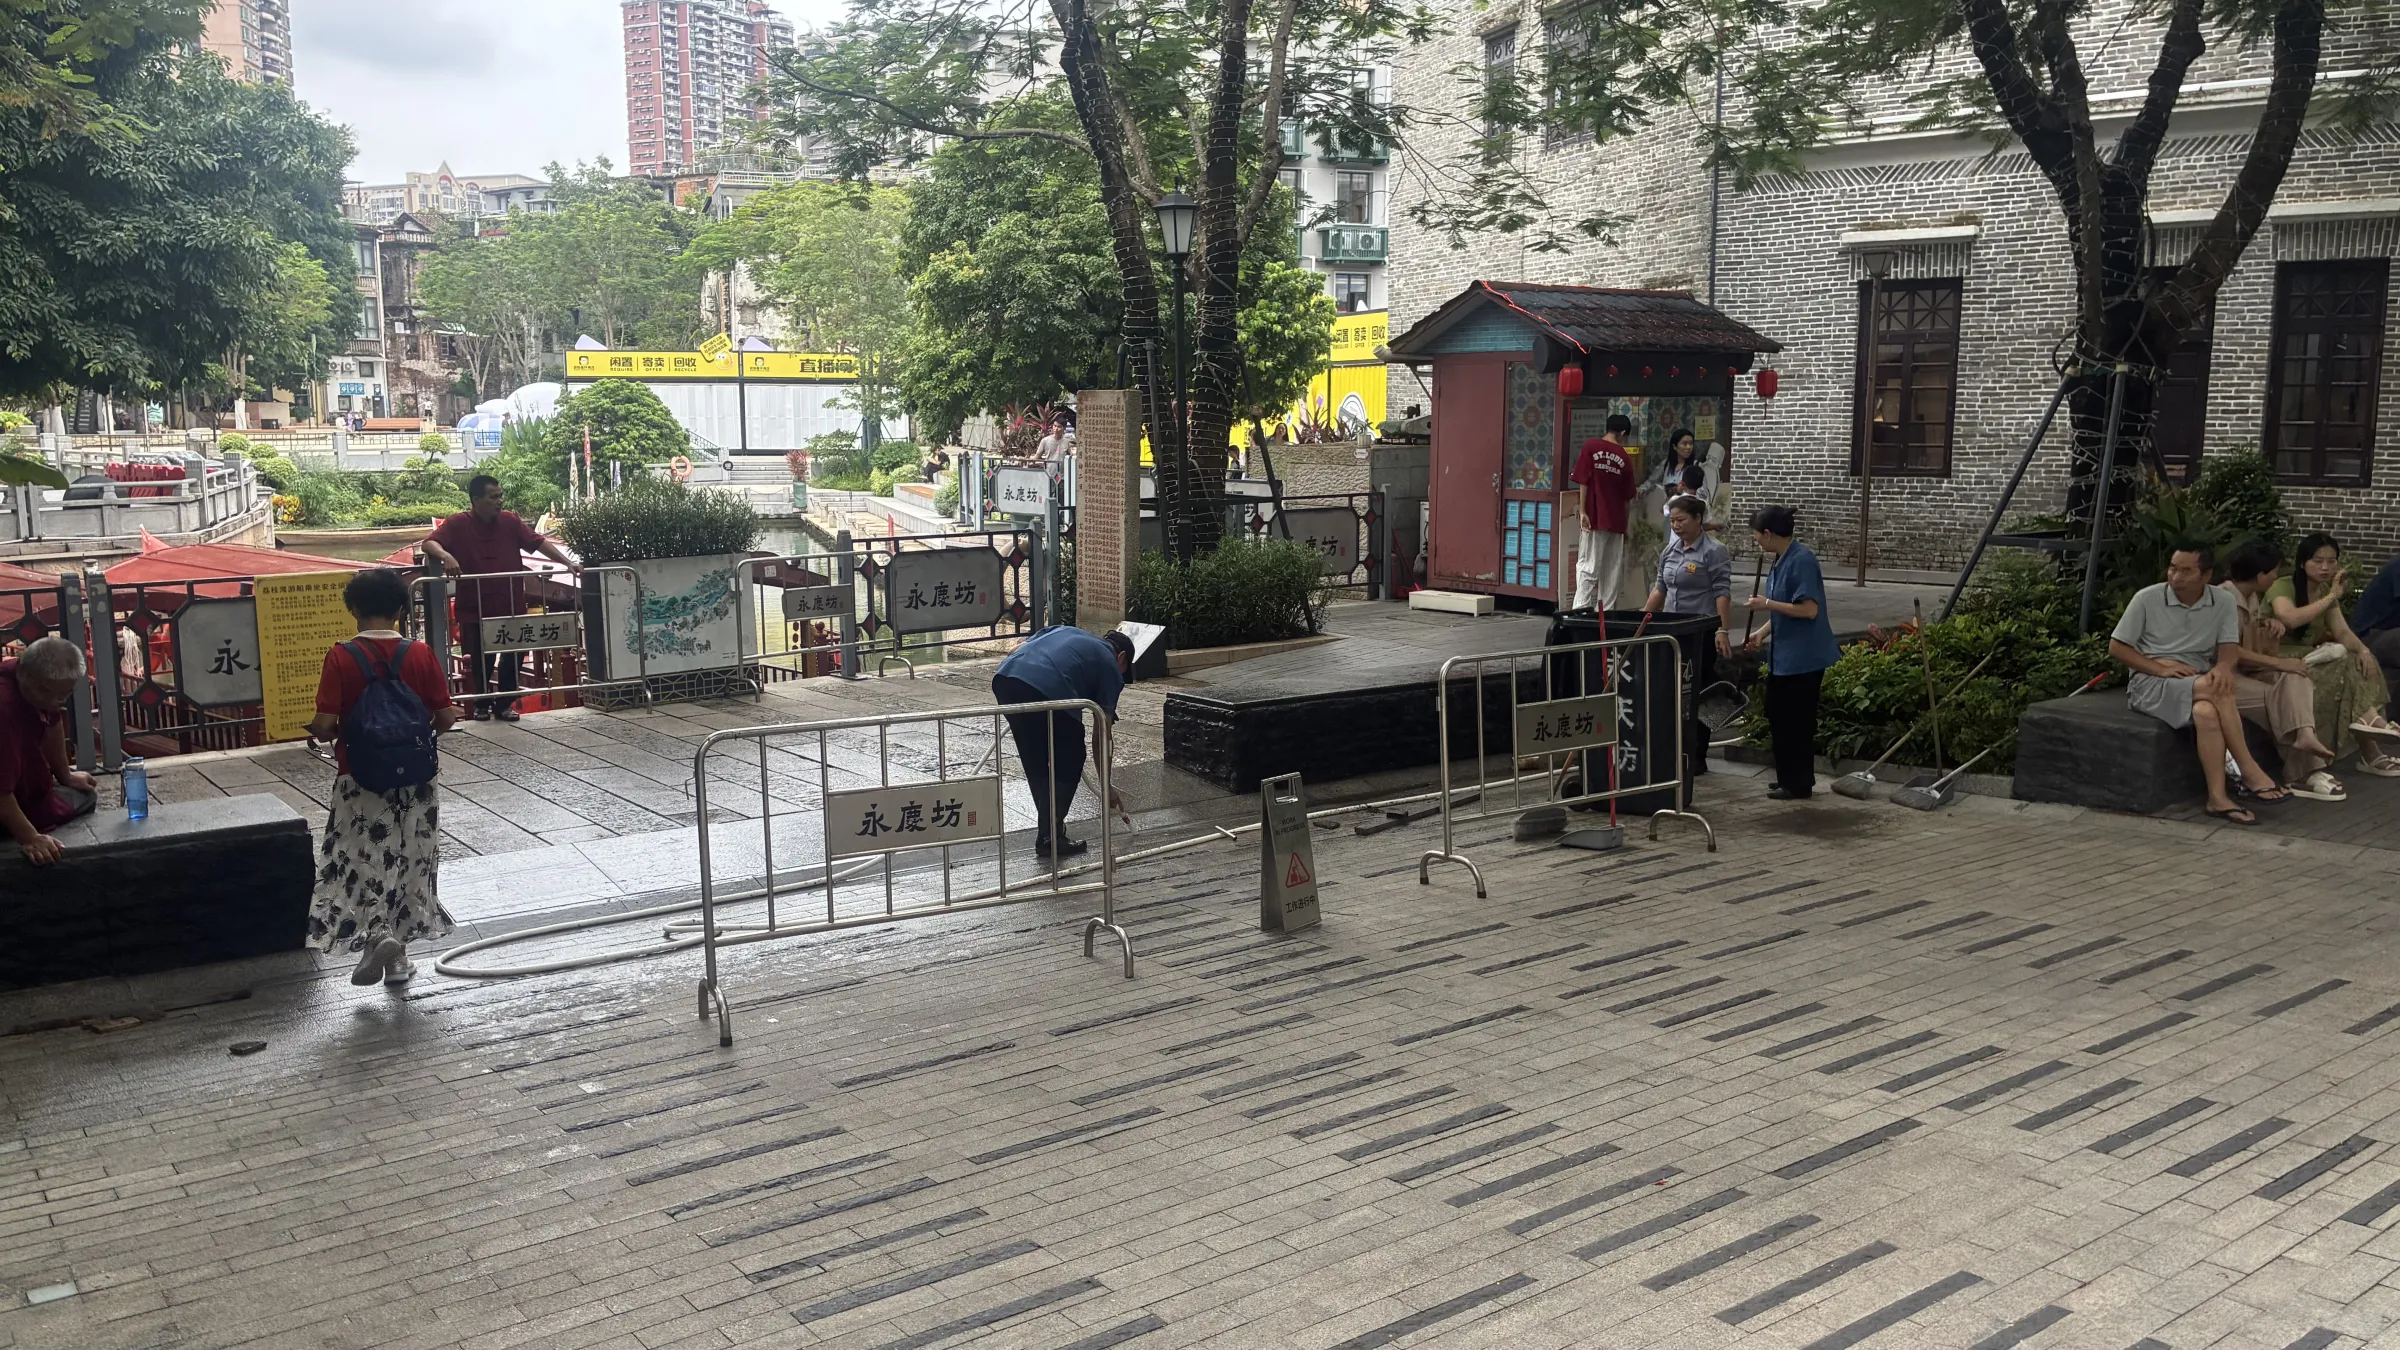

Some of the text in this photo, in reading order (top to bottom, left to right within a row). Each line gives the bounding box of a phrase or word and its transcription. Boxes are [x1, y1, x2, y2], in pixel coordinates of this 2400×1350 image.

[610, 356, 697, 368] 闲置 寄卖 回收
[799, 358, 853, 374] 直播间
[206, 639, 260, 675] 永
[1282, 816, 1297, 825] WORK
[1281, 823, 1306, 835] PROGRESS
[1285, 895, 1316, 913] 工作进行中
